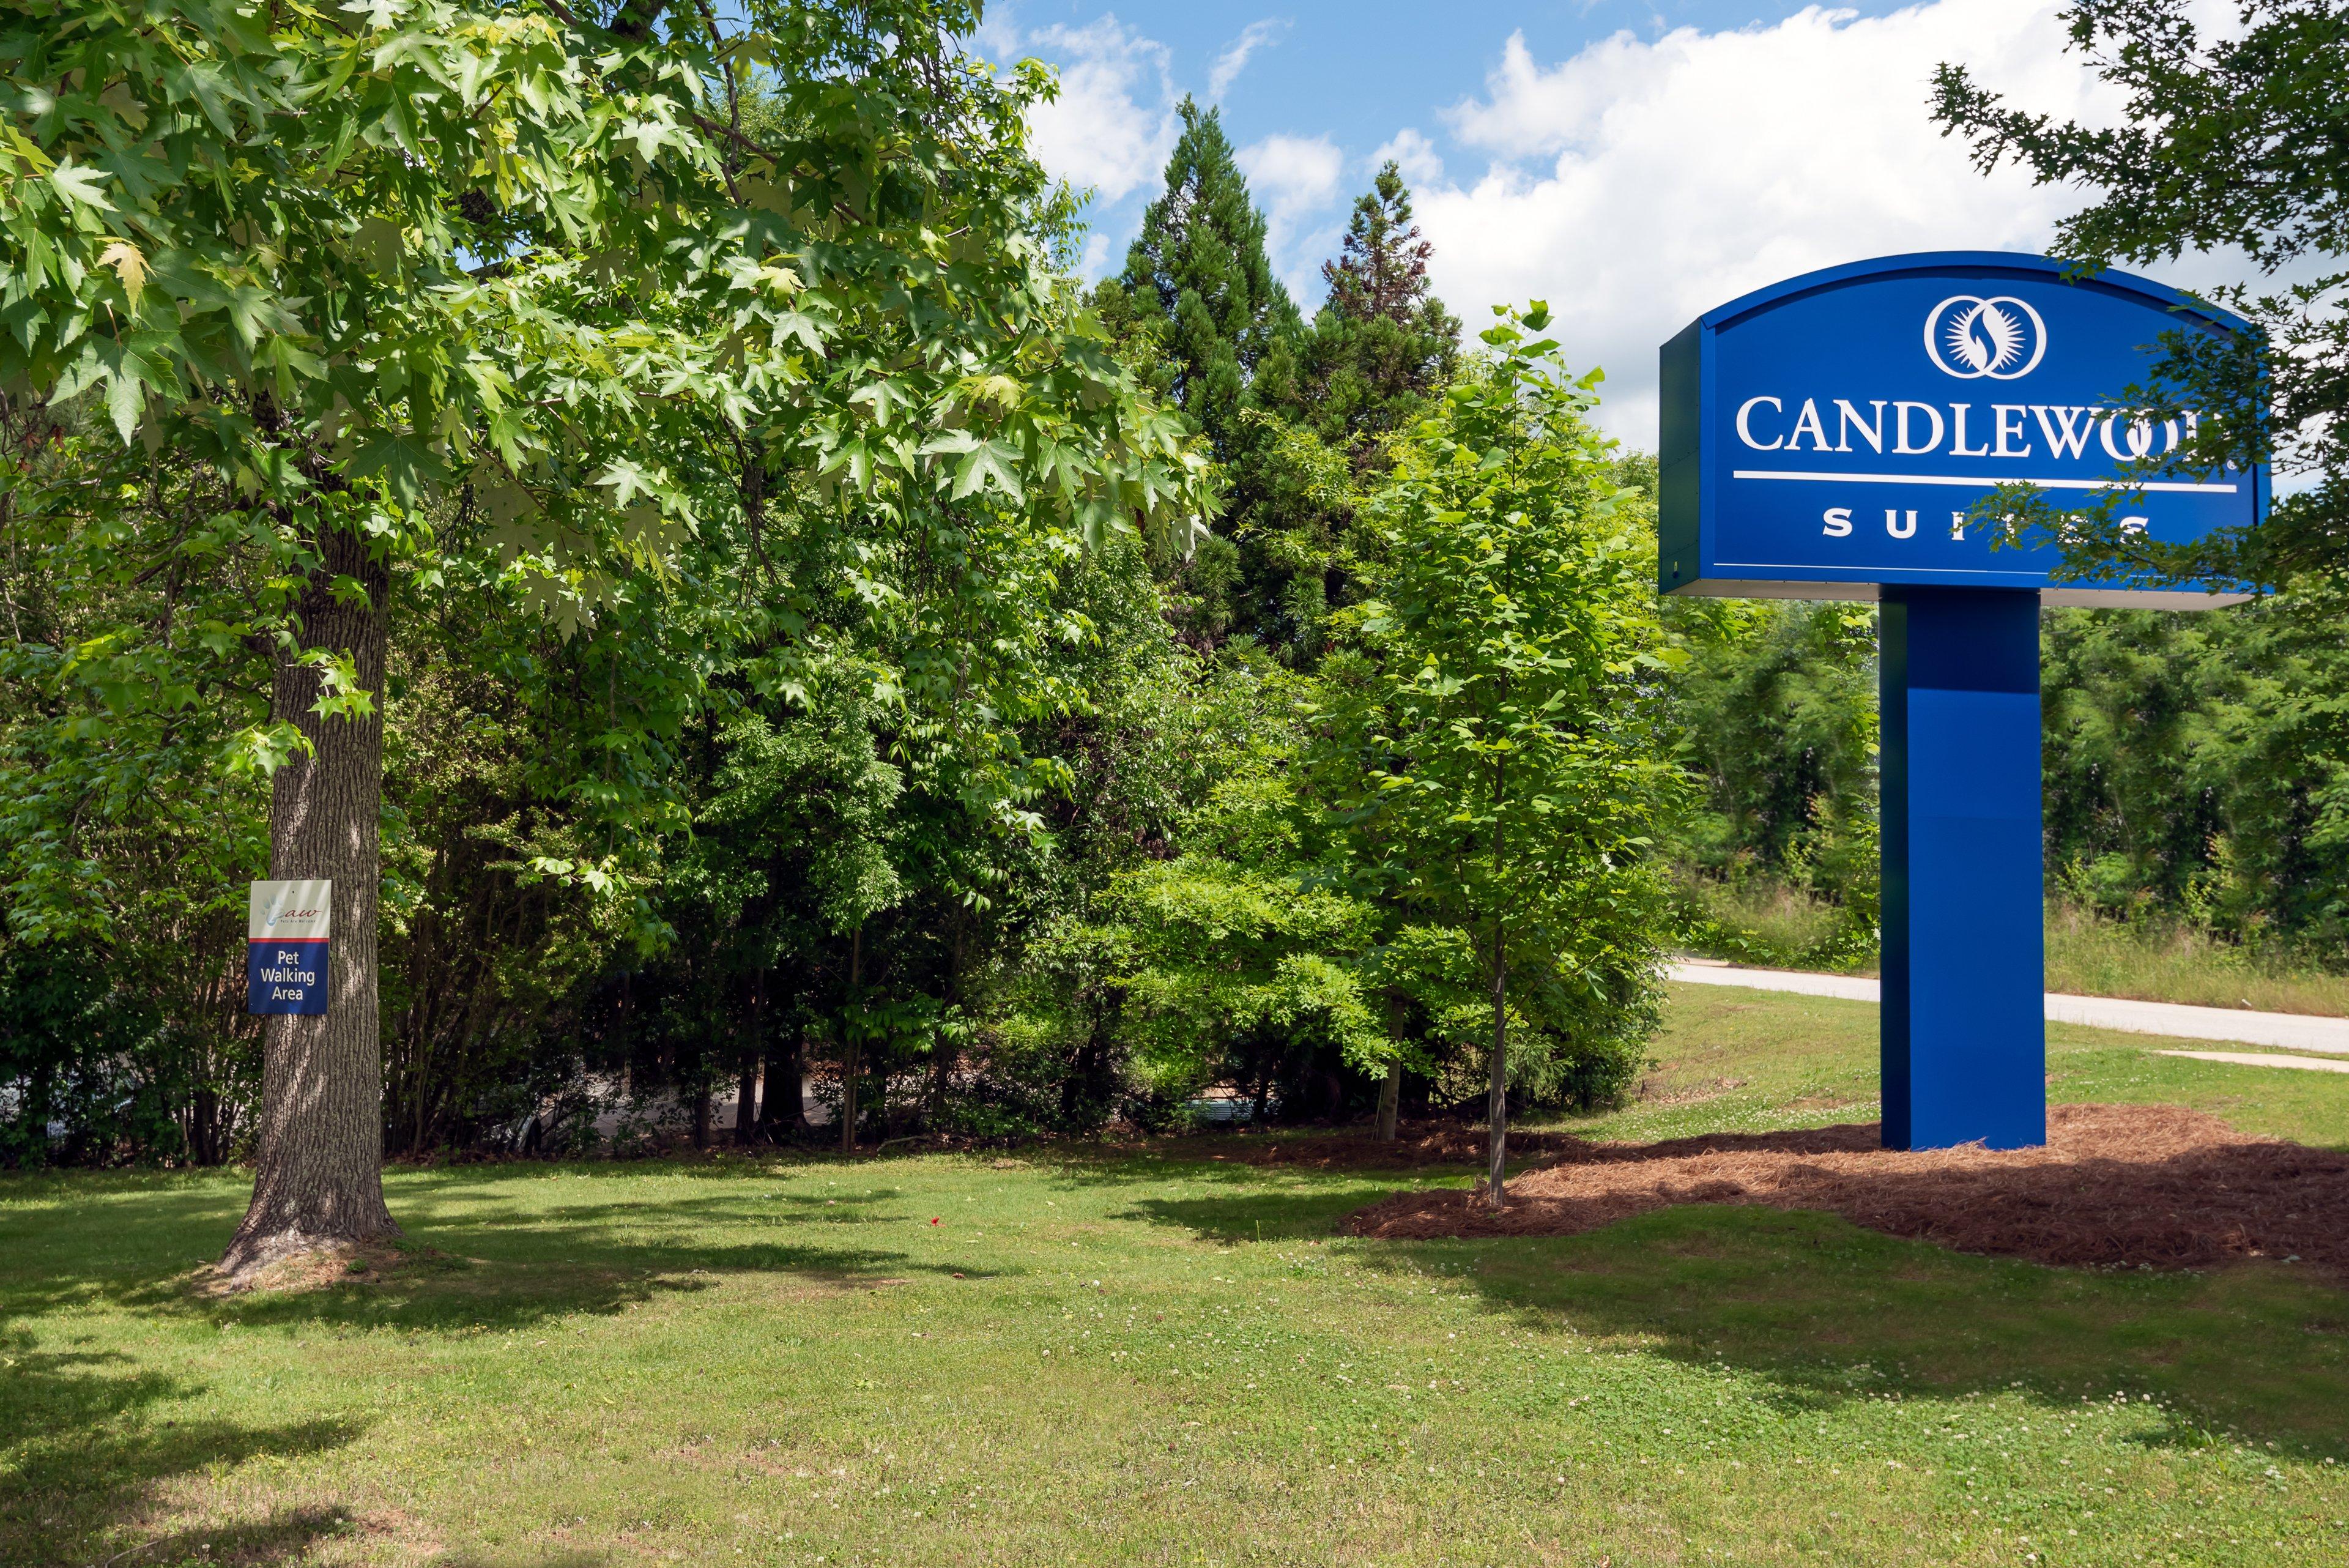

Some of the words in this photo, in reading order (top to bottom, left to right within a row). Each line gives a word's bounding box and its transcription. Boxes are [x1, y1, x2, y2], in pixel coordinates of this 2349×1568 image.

[278, 950, 299, 965] Pet
[261, 968, 316, 986] Walking
[272, 986, 303, 1000] Area
